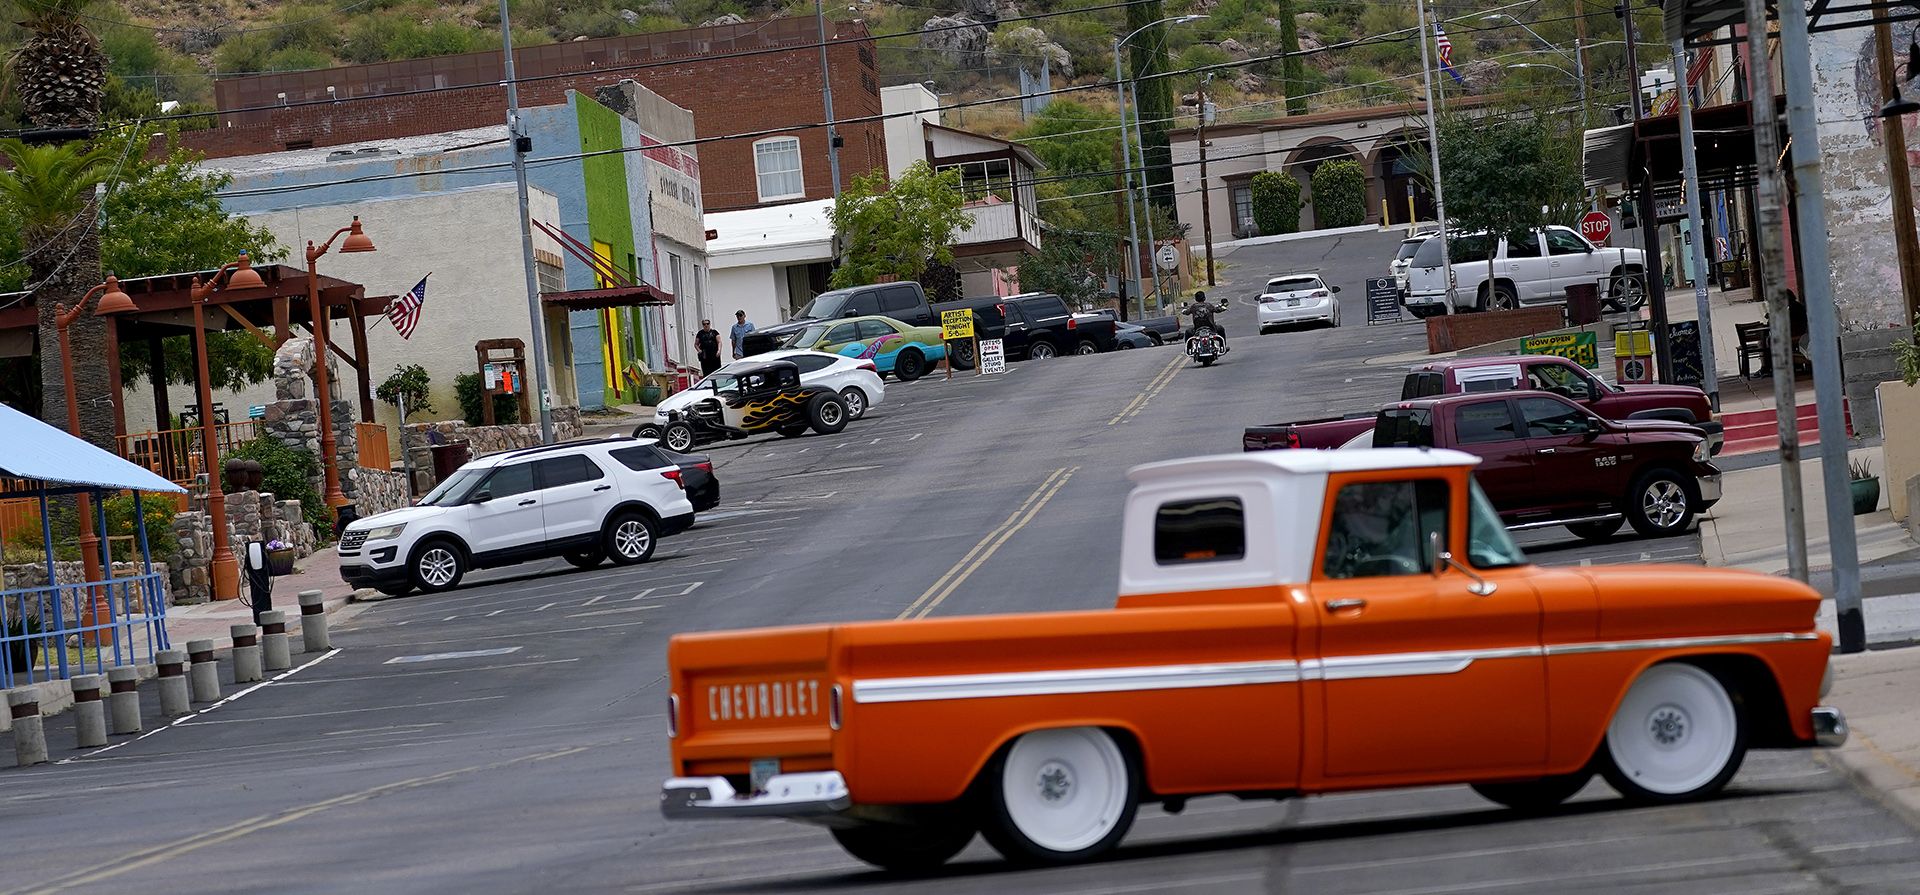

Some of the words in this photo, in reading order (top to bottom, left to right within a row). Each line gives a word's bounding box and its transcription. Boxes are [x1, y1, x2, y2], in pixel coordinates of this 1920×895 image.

[1583, 220, 1609, 234] STOP
[943, 316, 971, 324] RECEPTION
[946, 322, 970, 330] TONIGHT
[1529, 339, 1549, 347] NOW
[1550, 335, 1571, 343] OPEN
[708, 680, 819, 720] CHEVROLET
